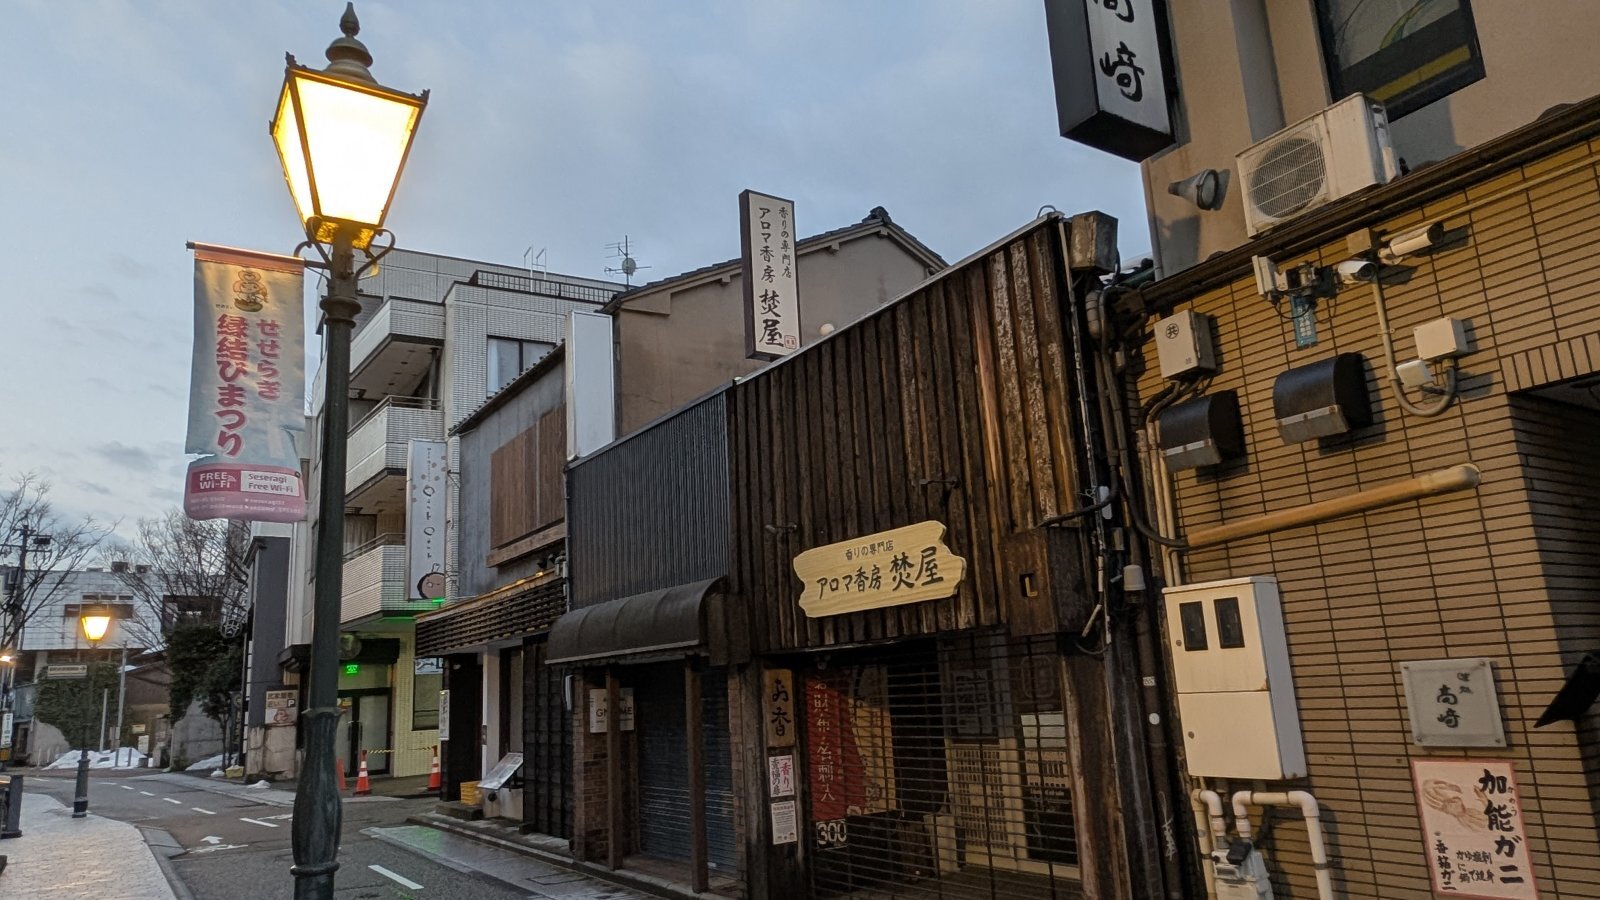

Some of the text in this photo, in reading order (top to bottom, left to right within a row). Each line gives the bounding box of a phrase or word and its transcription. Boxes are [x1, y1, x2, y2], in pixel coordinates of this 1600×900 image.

[759, 207, 784, 347] アロマ香房 焚屋
[256, 319, 282, 401] せせらぎ
[215, 313, 249, 457] 縁結びまつり
[200, 472, 228, 481] FREE
[200, 480, 231, 489] Wi-Fi
[248, 473, 287, 483] Seseragi
[248, 482, 293, 493] Free Wi-Fi
[845, 540, 894, 561] 香りの専門店
[816, 546, 944, 600] アロマ香房 焚屋
[817, 822, 847, 845] 300
[1478, 768, 1524, 884] 加能ガニ
